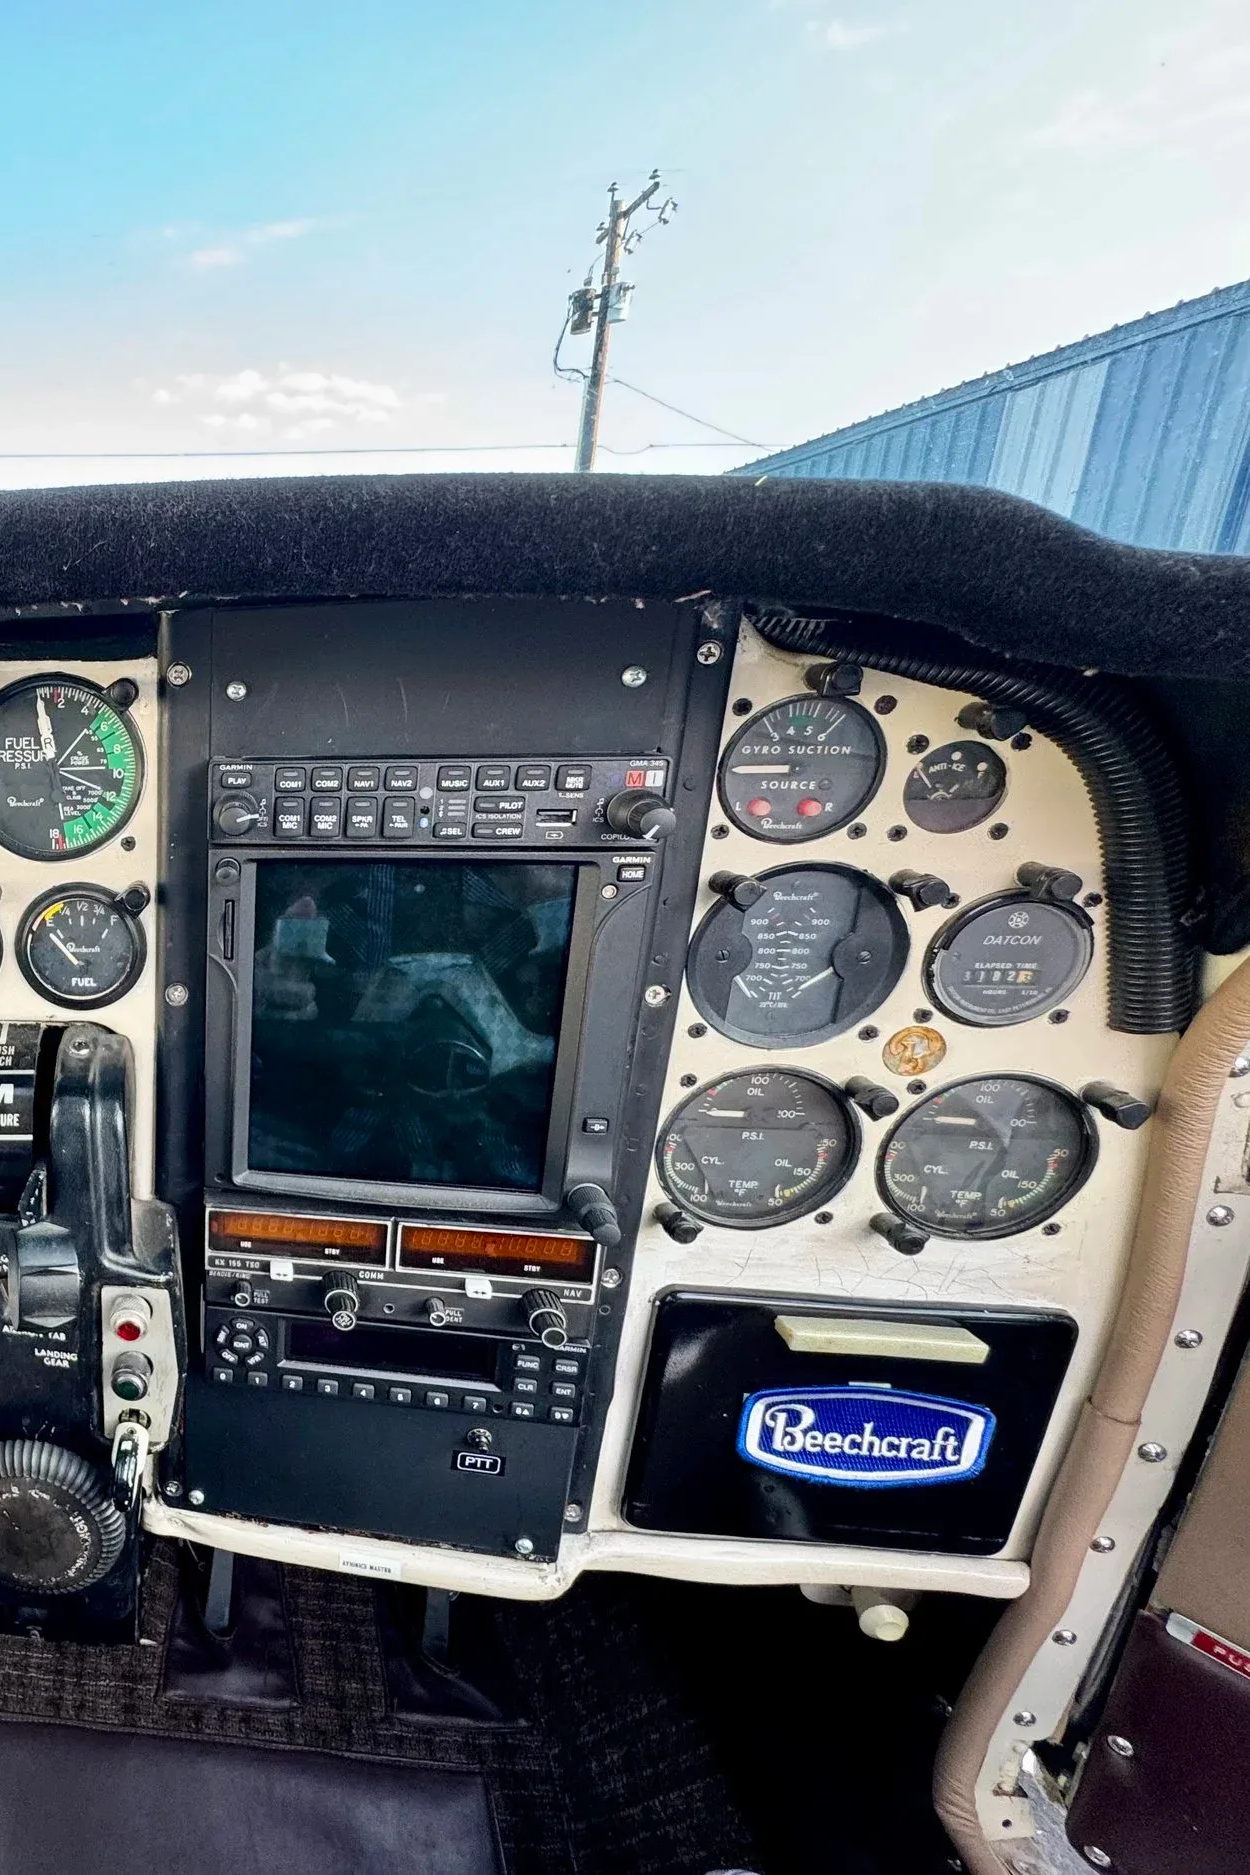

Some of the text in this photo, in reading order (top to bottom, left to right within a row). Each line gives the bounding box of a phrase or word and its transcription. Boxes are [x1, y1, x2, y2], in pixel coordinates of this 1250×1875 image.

[5, 737, 40, 750] FUEL
[742, 745, 851, 754] GYRO SUCTION
[228, 777, 246, 785] PLAY
[441, 779, 468, 787] MUSIC
[483, 779, 505, 787] AUX1
[760, 780, 817, 790] SOURCE
[352, 815, 372, 823] SPKR
[496, 827, 520, 835] CREW
[613, 856, 651, 864] GARMIN
[622, 870, 644, 879] HOME
[750, 918, 769, 926] 900
[812, 918, 830, 926] 900
[982, 935, 1042, 945] DATCON
[758, 947, 775, 955] 800
[792, 947, 809, 955] 800
[71, 977, 97, 987] FUEL
[769, 992, 782, 1000] TIT
[751, 1077, 770, 1085] 100
[747, 1088, 764, 1096] OIL
[980, 1083, 1000, 1092] 100
[976, 1095, 993, 1104] OIL
[701, 1155, 724, 1165] CYL.
[775, 1159, 792, 1167] OIL
[675, 1162, 694, 1171] 300
[924, 1164, 948, 1174] CYL.
[793, 1168, 811, 1176] 150
[1001, 1169, 1019, 1179] OIL
[893, 1173, 915, 1182] 300
[729, 1180, 758, 1189] TEMP.
[1017, 1181, 1037, 1189] 150
[690, 1194, 707, 1202] 100
[951, 1190, 982, 1200] TEMP.
[907, 1203, 926, 1212] 100
[990, 1208, 1005, 1217] 50
[359, 1271, 384, 1280] COMM
[563, 1289, 582, 1297] NAV
[34, 1348, 78, 1361] LANDING
[44, 1357, 69, 1368] GEAR
[555, 1364, 578, 1372] CRSR
[765, 1403, 959, 1462] Beechcraft
[465, 1457, 493, 1469] PTT
[342, 1560, 391, 1573] AVIONICS MASTER
